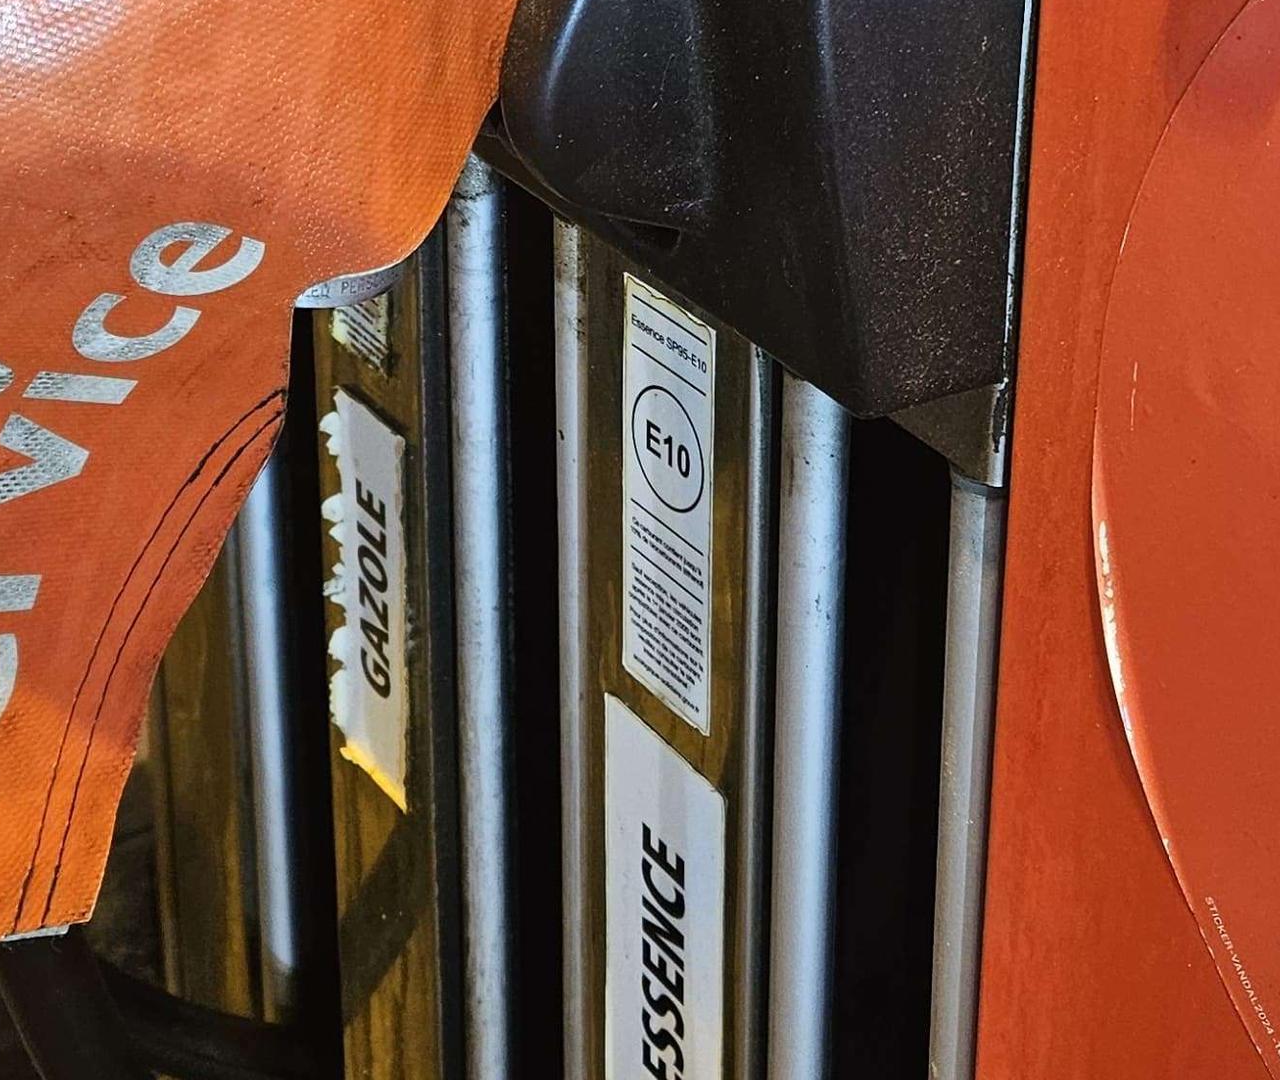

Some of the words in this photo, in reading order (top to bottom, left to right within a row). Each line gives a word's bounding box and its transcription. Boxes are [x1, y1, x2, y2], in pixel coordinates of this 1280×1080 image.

[631, 313, 665, 345] Essence
[665, 336, 708, 374] SP95-E10
[645, 418, 691, 478] E10
[355, 477, 391, 699] GAZOLE
[642, 822, 686, 1080] ESSENCE
